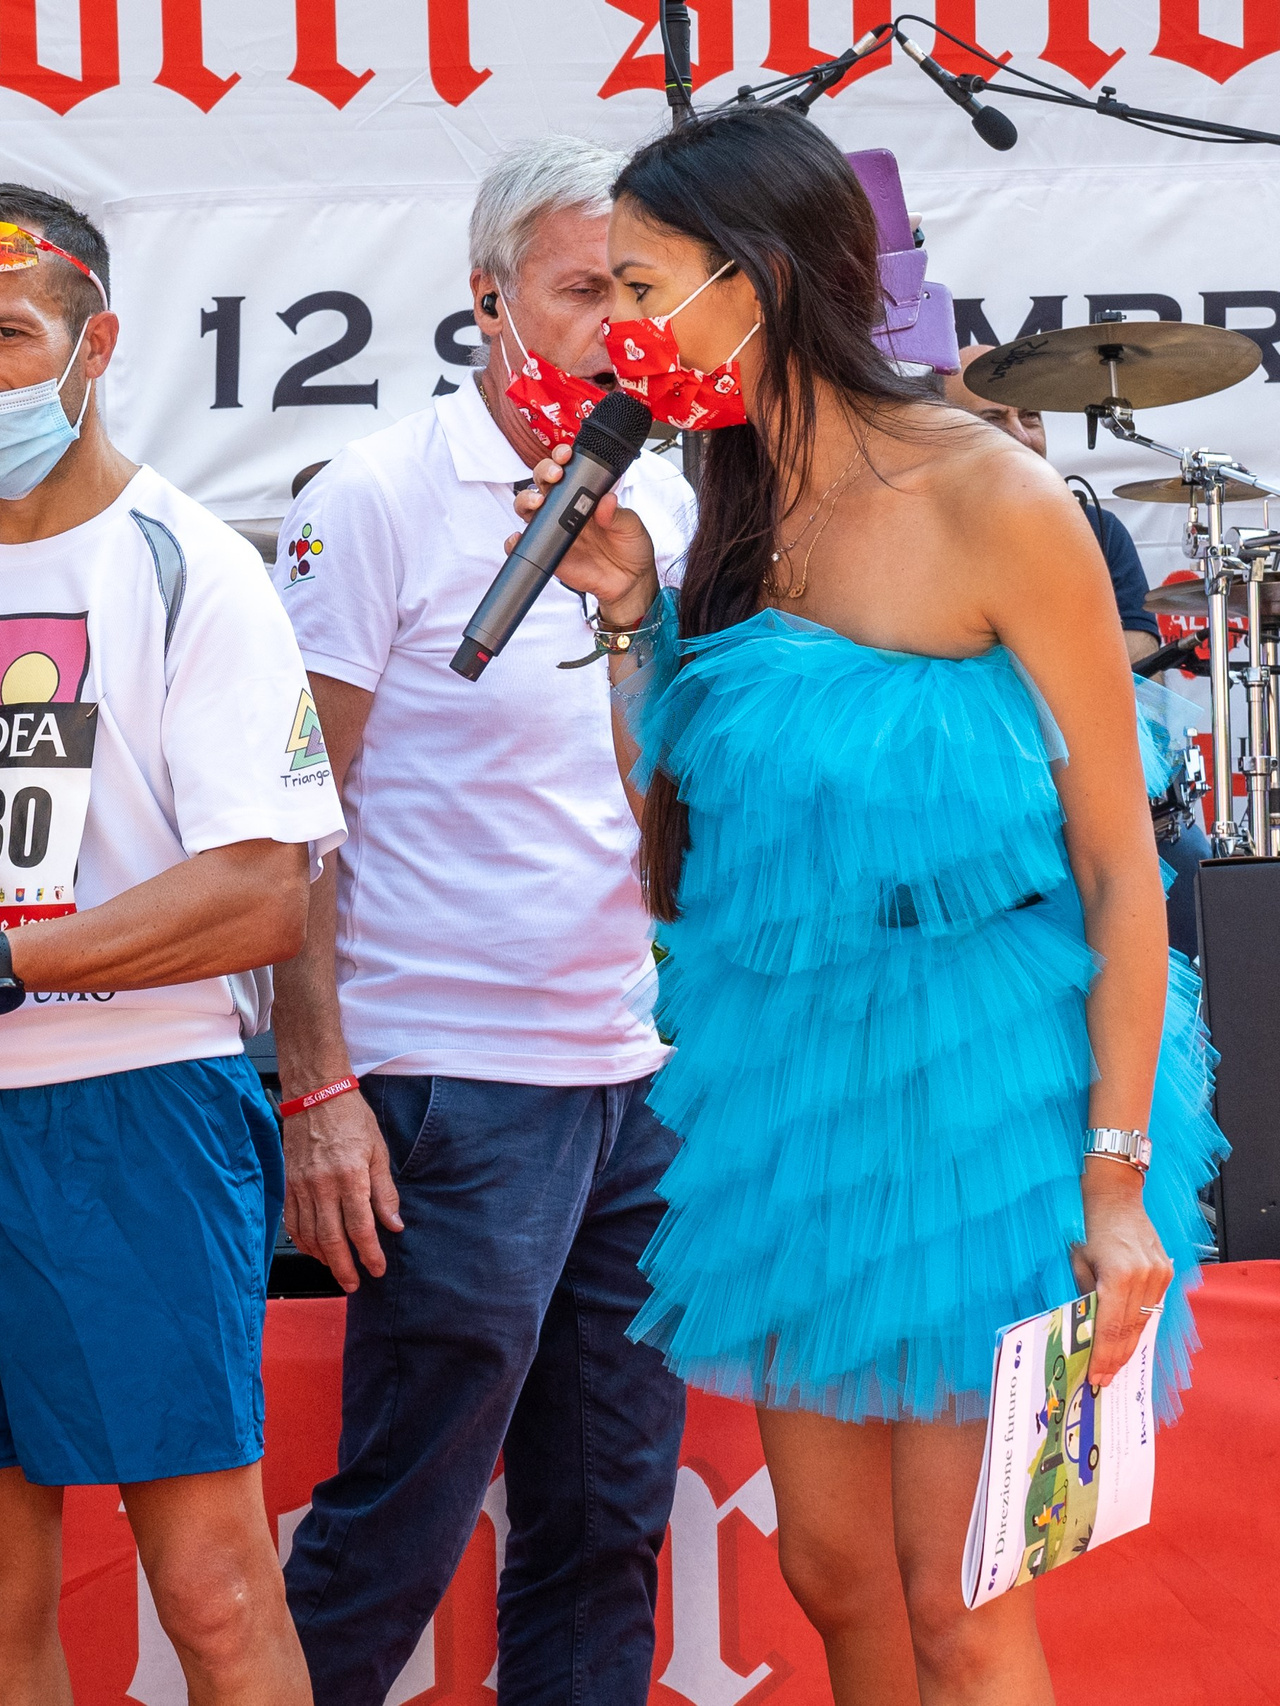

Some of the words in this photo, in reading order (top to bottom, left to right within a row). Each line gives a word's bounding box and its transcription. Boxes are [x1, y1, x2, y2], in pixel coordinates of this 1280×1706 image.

[200, 289, 379, 413] 12
[314, 1079, 352, 1102] GENERALI
[994, 1448, 1014, 1558] Direzione
[1004, 1375, 1019, 1444] futuro
